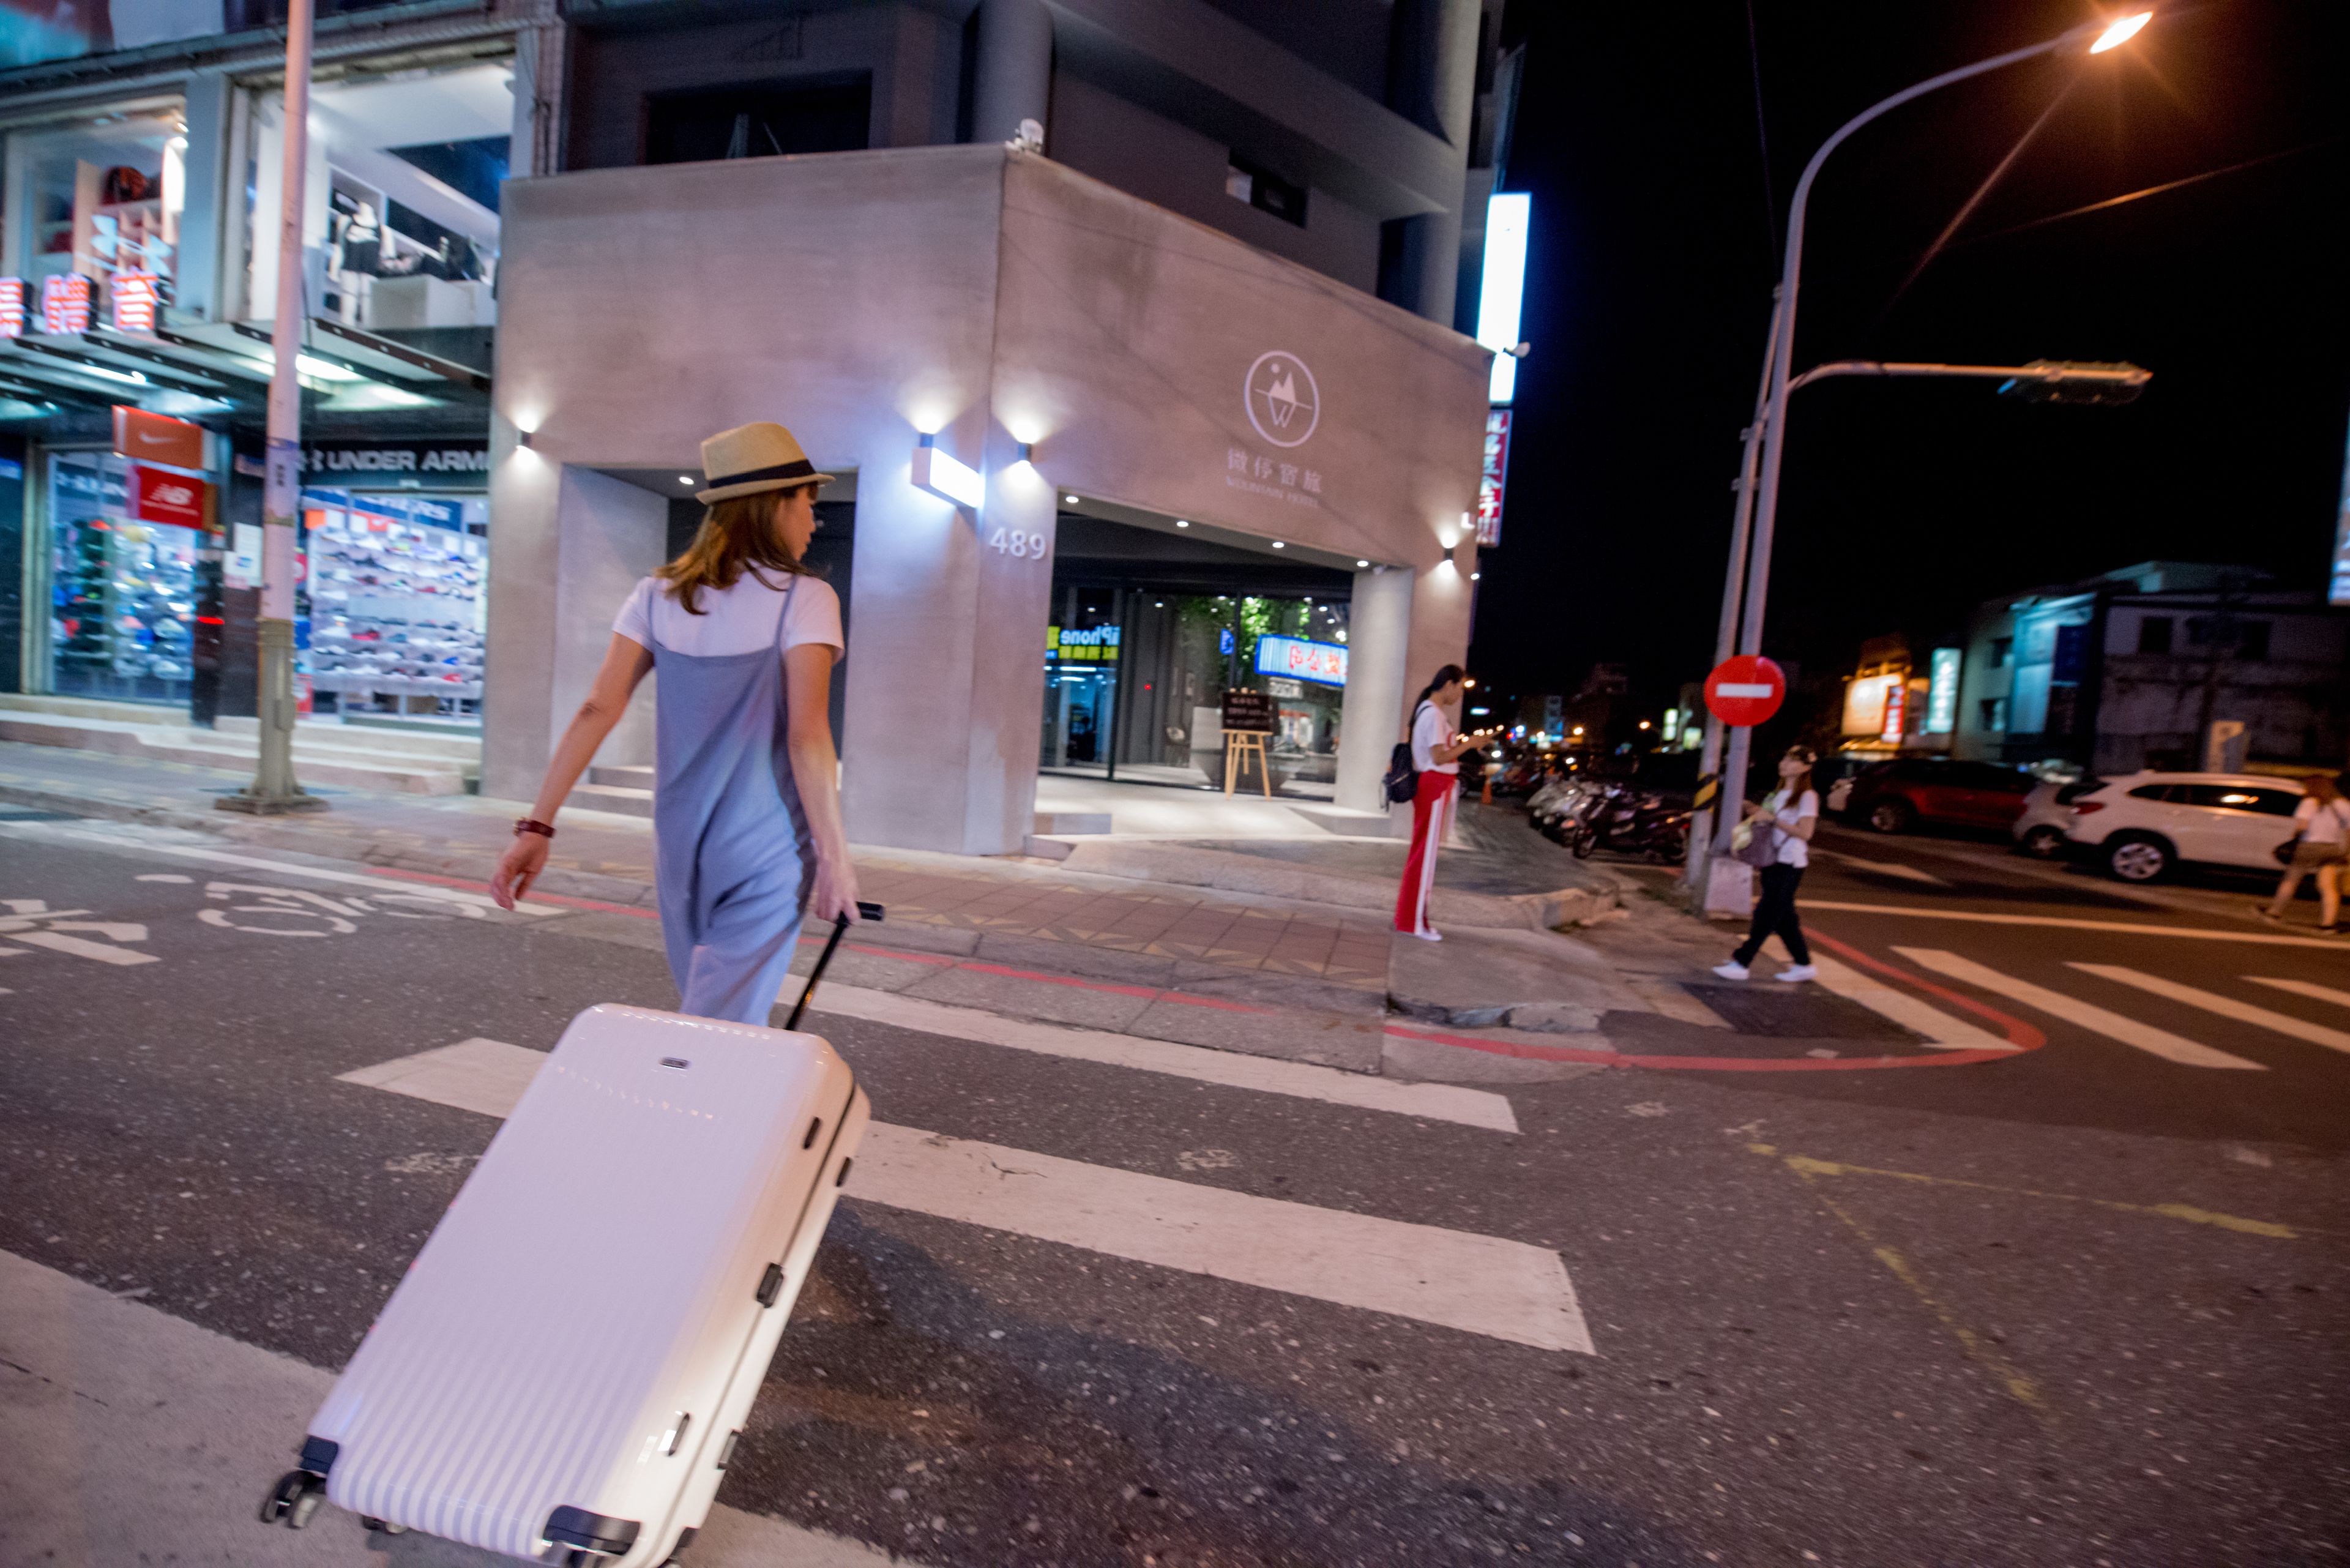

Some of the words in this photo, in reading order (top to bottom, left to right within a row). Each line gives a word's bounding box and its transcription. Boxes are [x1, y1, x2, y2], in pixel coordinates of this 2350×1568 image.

[327, 449, 417, 471] UNDER
[420, 450, 488, 471] ARM
[989, 526, 1047, 561] 489
